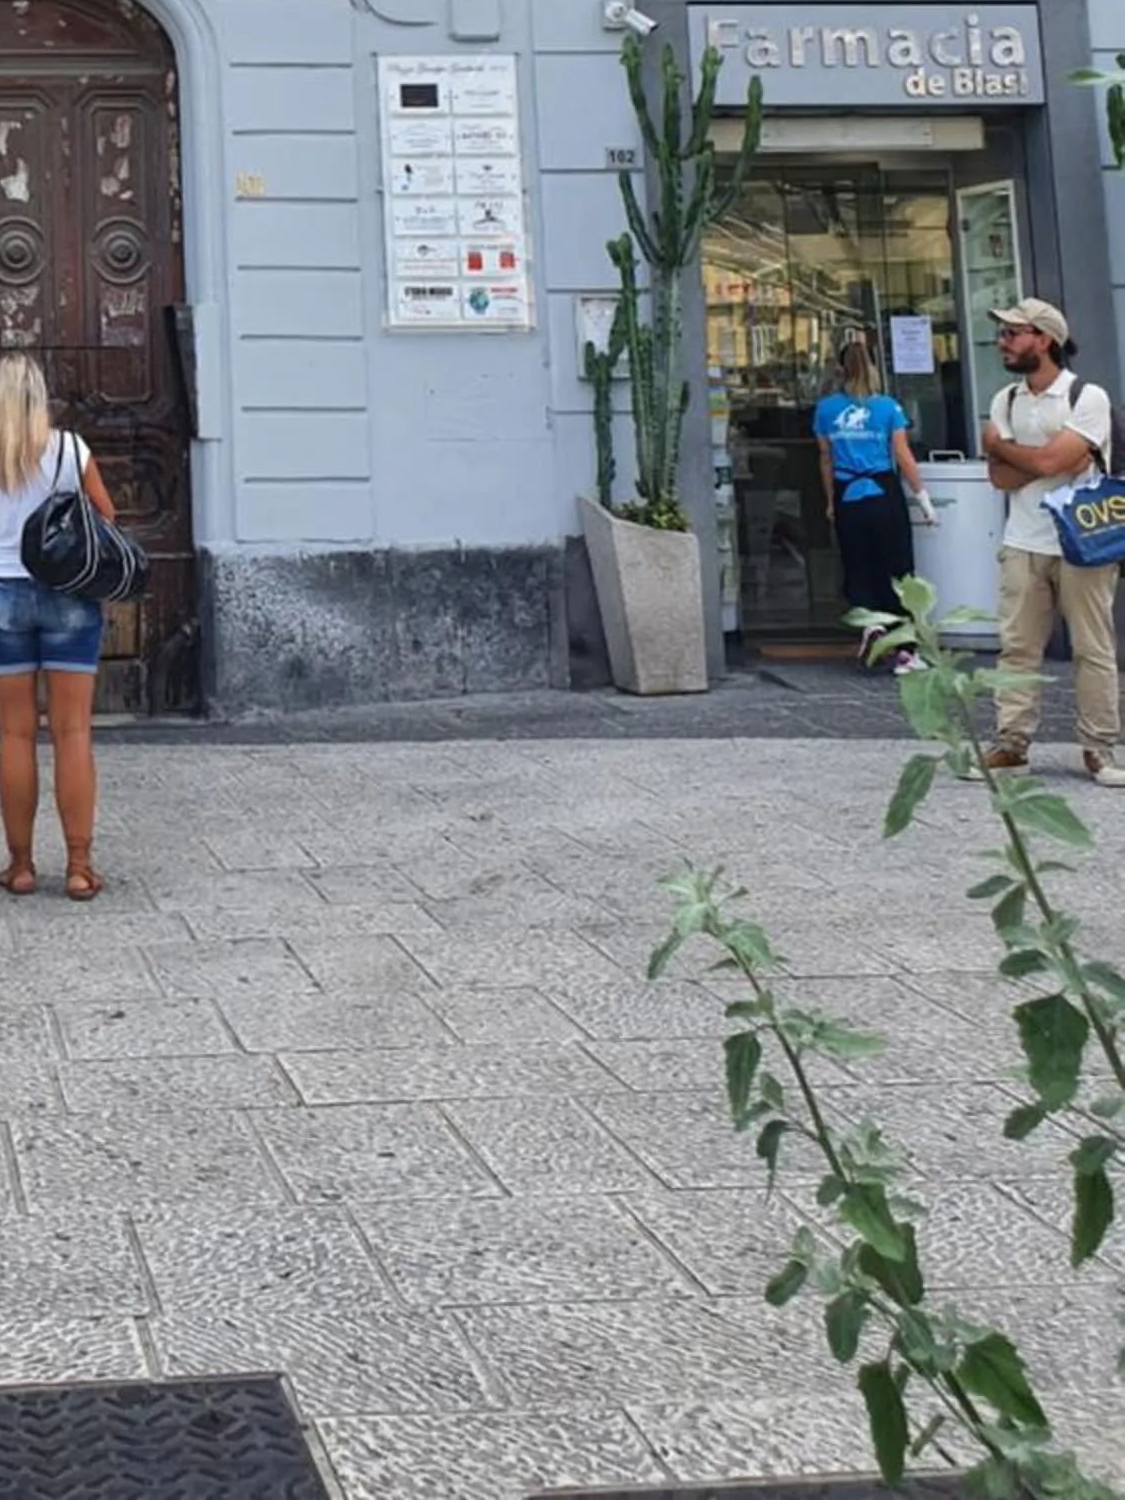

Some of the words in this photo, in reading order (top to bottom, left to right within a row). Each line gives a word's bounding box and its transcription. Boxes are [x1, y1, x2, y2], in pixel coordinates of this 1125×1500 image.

[706, 12, 1025, 68] Farmacia
[905, 68, 947, 97] de
[954, 68, 1029, 97] Blasi
[1076, 495, 1125, 528] OVS
